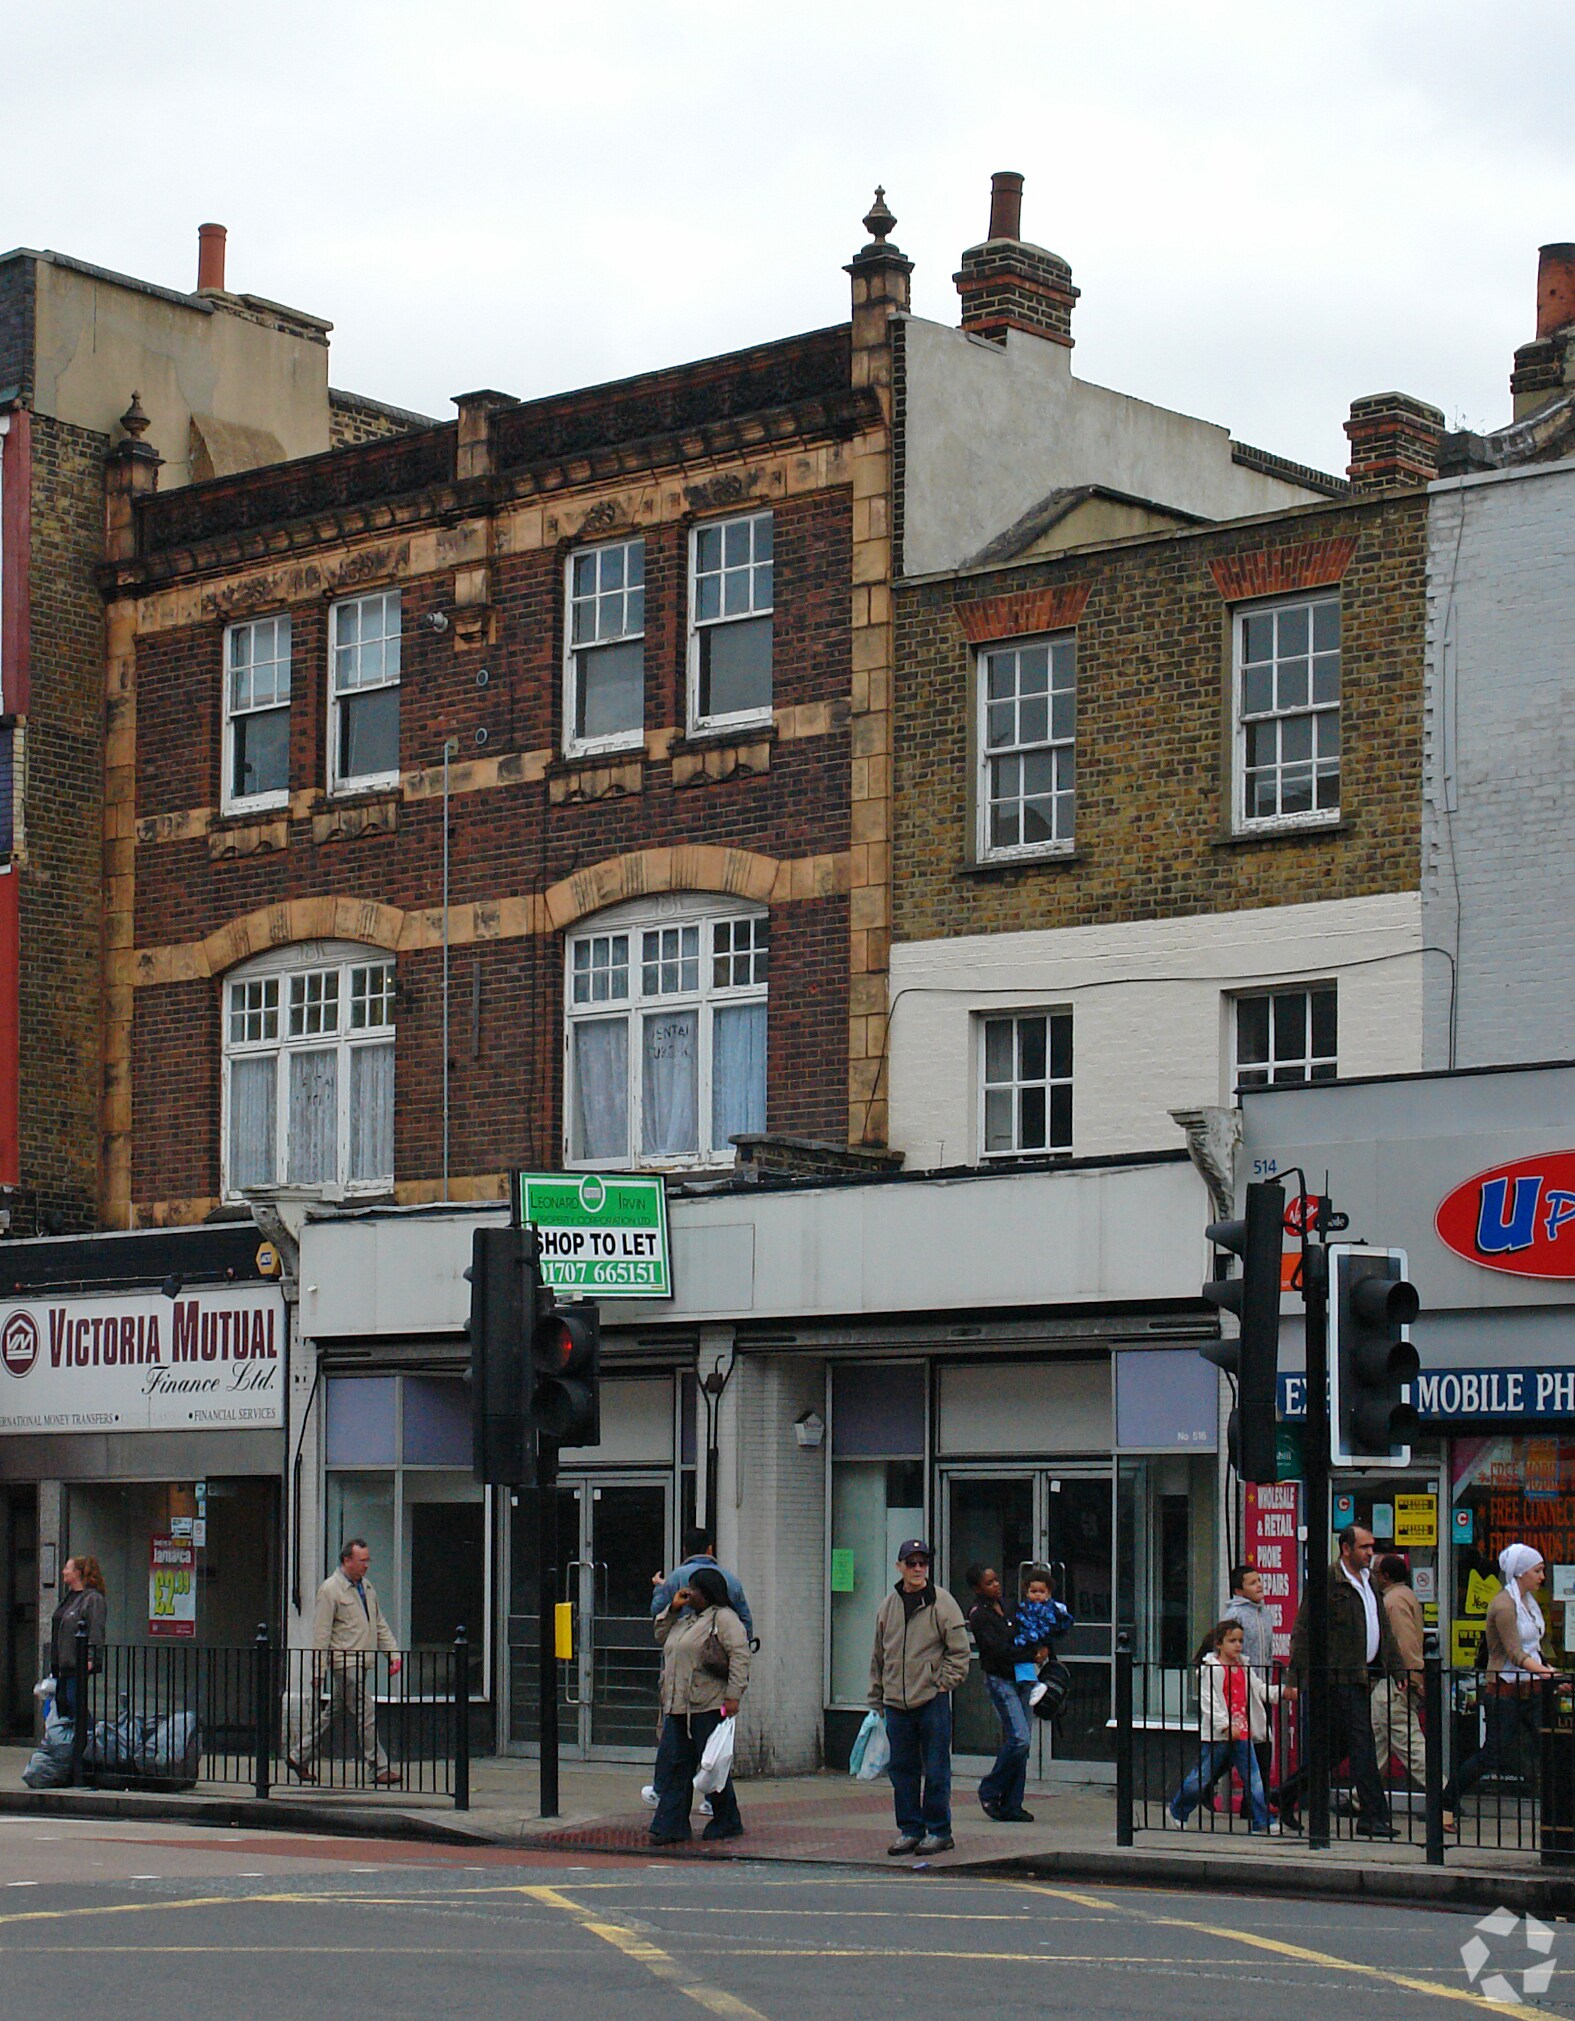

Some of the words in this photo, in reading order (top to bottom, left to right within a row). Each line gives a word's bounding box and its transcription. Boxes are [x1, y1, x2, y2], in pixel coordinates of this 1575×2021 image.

[1253, 1159, 1277, 1174] 514
[530, 1191, 580, 1209] LEONARD
[618, 1192, 646, 1211] IRVIN
[537, 1215, 575, 1224] PROPERTY
[577, 1215, 636, 1225] CORPORATION
[637, 1216, 651, 1226] LTD
[590, 1232, 616, 1256] TO
[622, 1233, 657, 1256] LET
[593, 1262, 656, 1283] 665151
[49, 1308, 161, 1368] VICTORIA
[172, 1300, 277, 1363] MUTUAL
[141, 1366, 220, 1395] Finance
[226, 1361, 277, 1392] Ltd.
[1417, 1373, 1524, 1413] MOBILE
[44, 1412, 69, 1425] MONEY
[71, 1412, 114, 1424] TRANSFERS
[194, 1408, 236, 1421] FINANCIAL
[238, 1407, 276, 1420] SERVICES
[1257, 1486, 1294, 1510] WHOLESALE
[1256, 1520, 1264, 1537] &
[1264, 1513, 1294, 1537] RETAIL
[1257, 1545, 1282, 1569] PHONE
